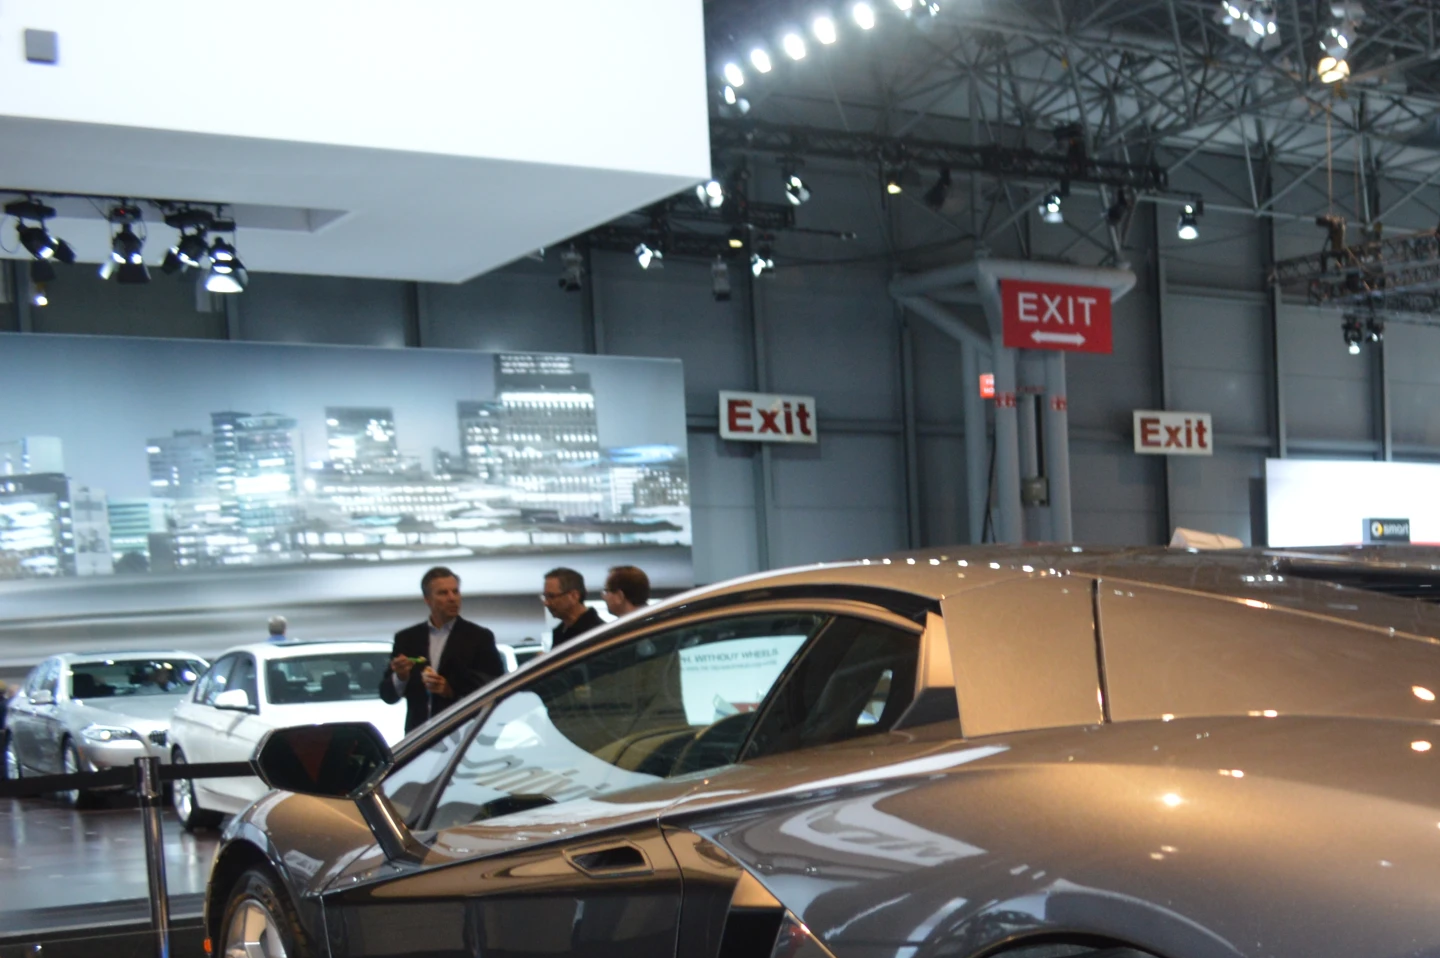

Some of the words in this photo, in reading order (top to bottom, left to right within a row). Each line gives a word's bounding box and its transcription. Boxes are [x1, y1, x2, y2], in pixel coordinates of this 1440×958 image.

[1017, 291, 1097, 327] EXIT
[727, 399, 812, 437] Exit
[1140, 416, 1208, 449] Exit
